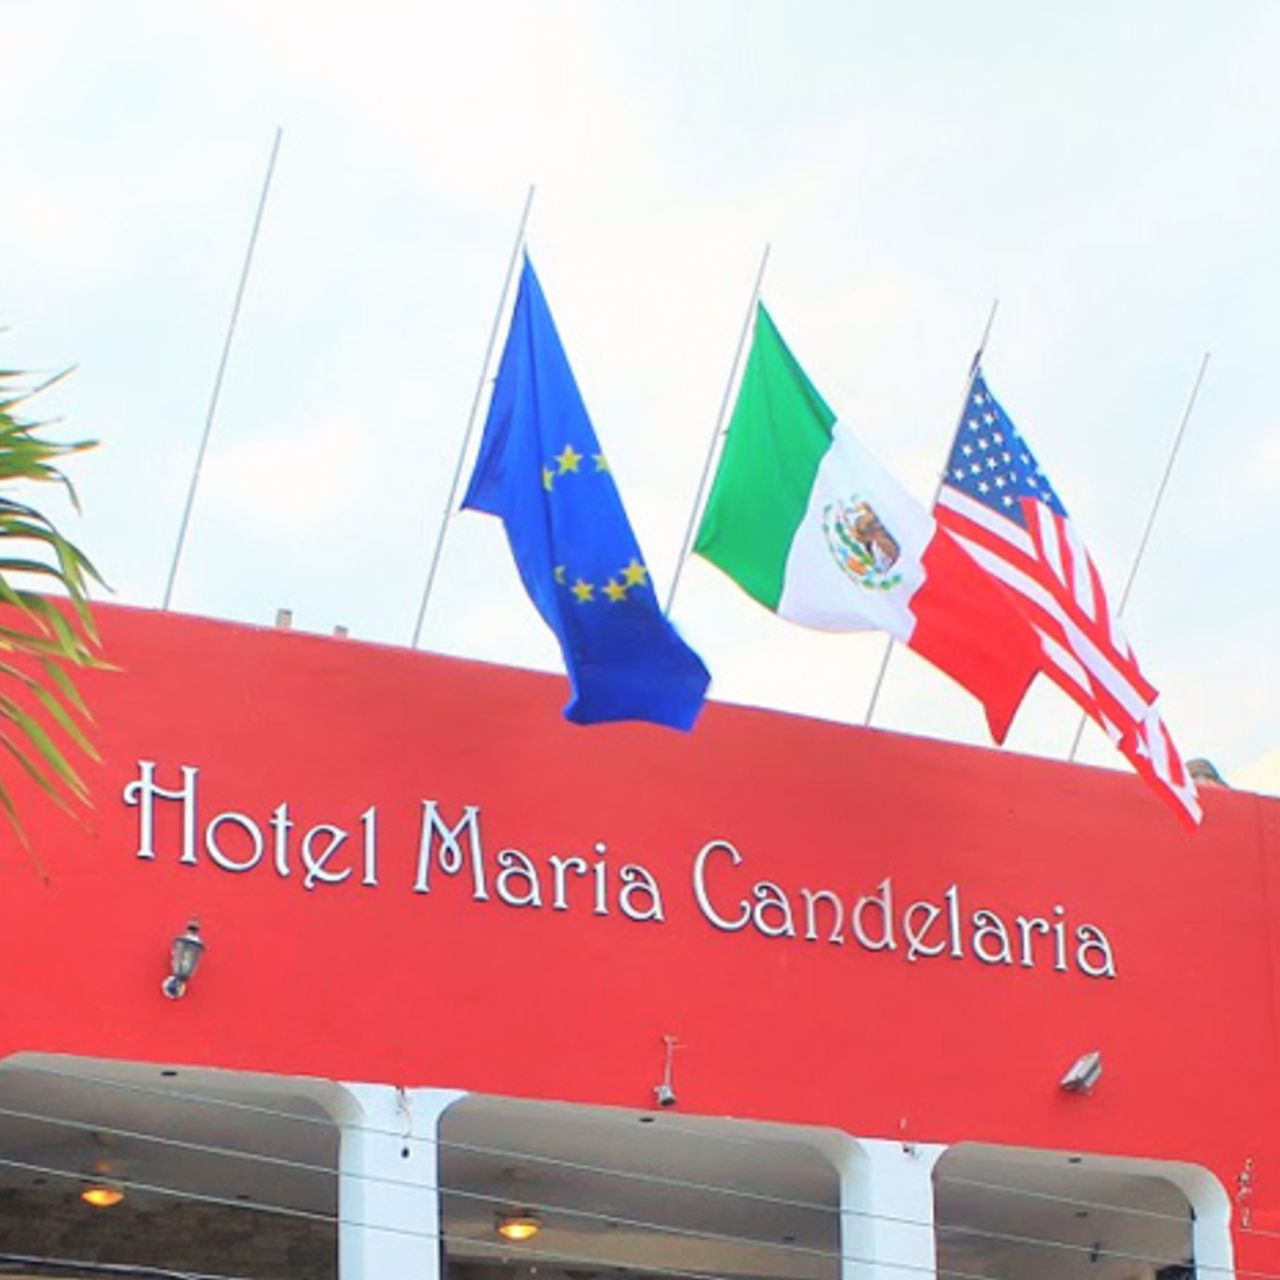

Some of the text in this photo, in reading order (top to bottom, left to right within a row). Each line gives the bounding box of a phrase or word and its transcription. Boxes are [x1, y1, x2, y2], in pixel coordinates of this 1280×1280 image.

[122, 760, 1117, 978] Hotel Maria Candelaria
